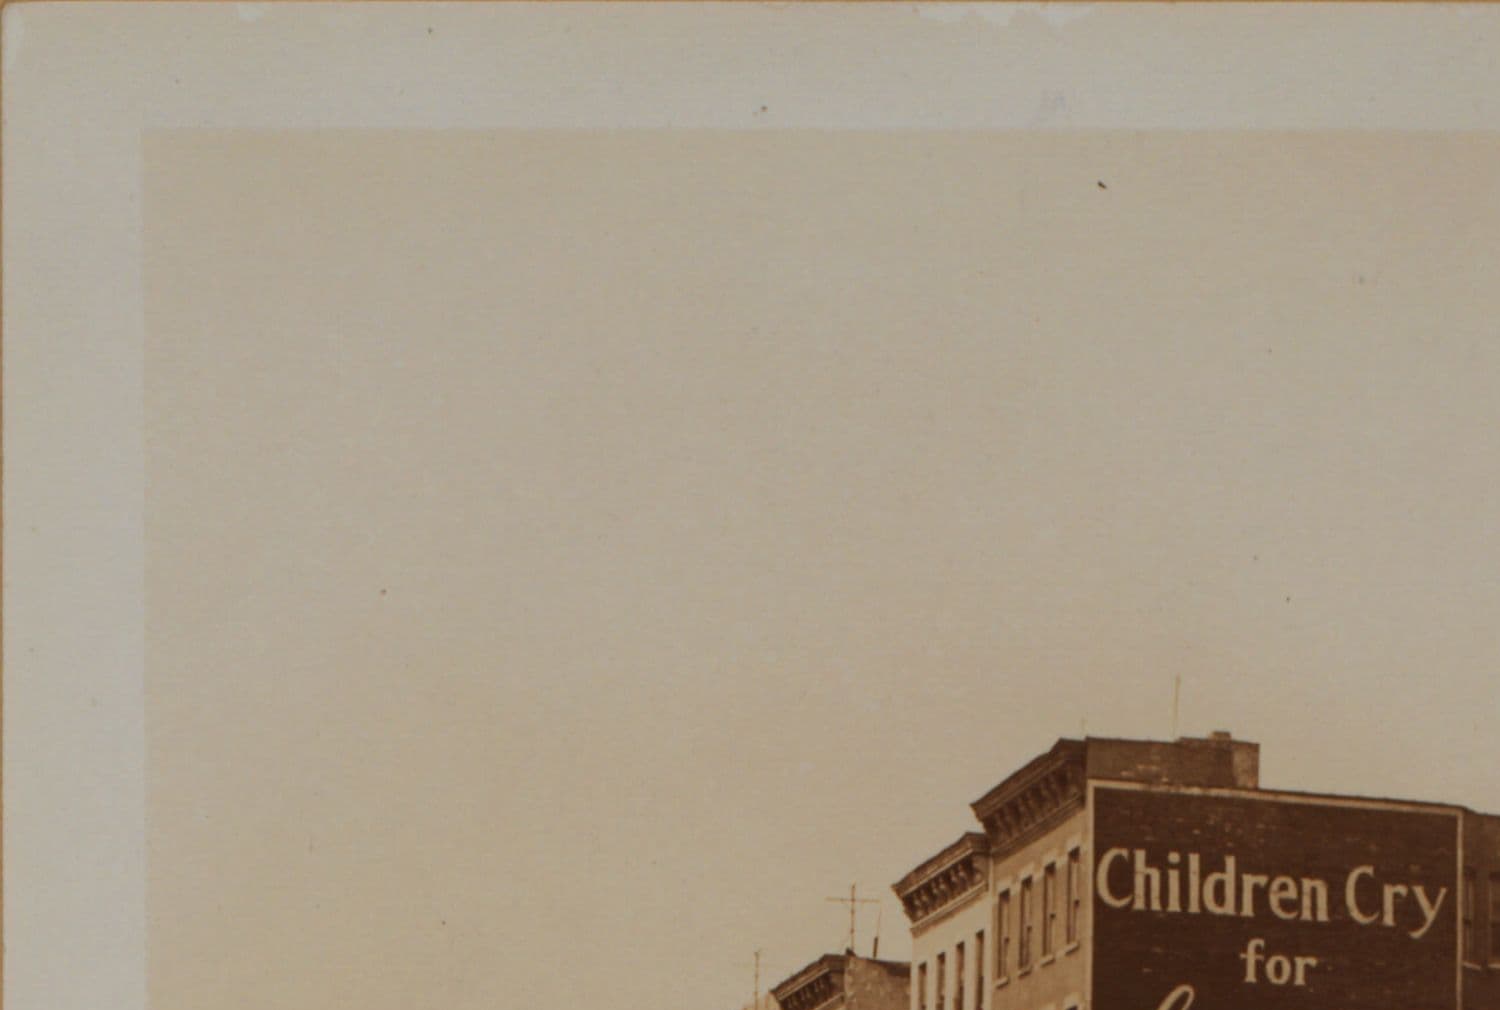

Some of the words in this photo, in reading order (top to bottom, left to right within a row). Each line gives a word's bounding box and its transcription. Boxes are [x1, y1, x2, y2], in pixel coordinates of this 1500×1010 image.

[1095, 846, 1331, 922] Children
[1344, 865, 1447, 939] Cry
[1239, 938, 1318, 987] for
